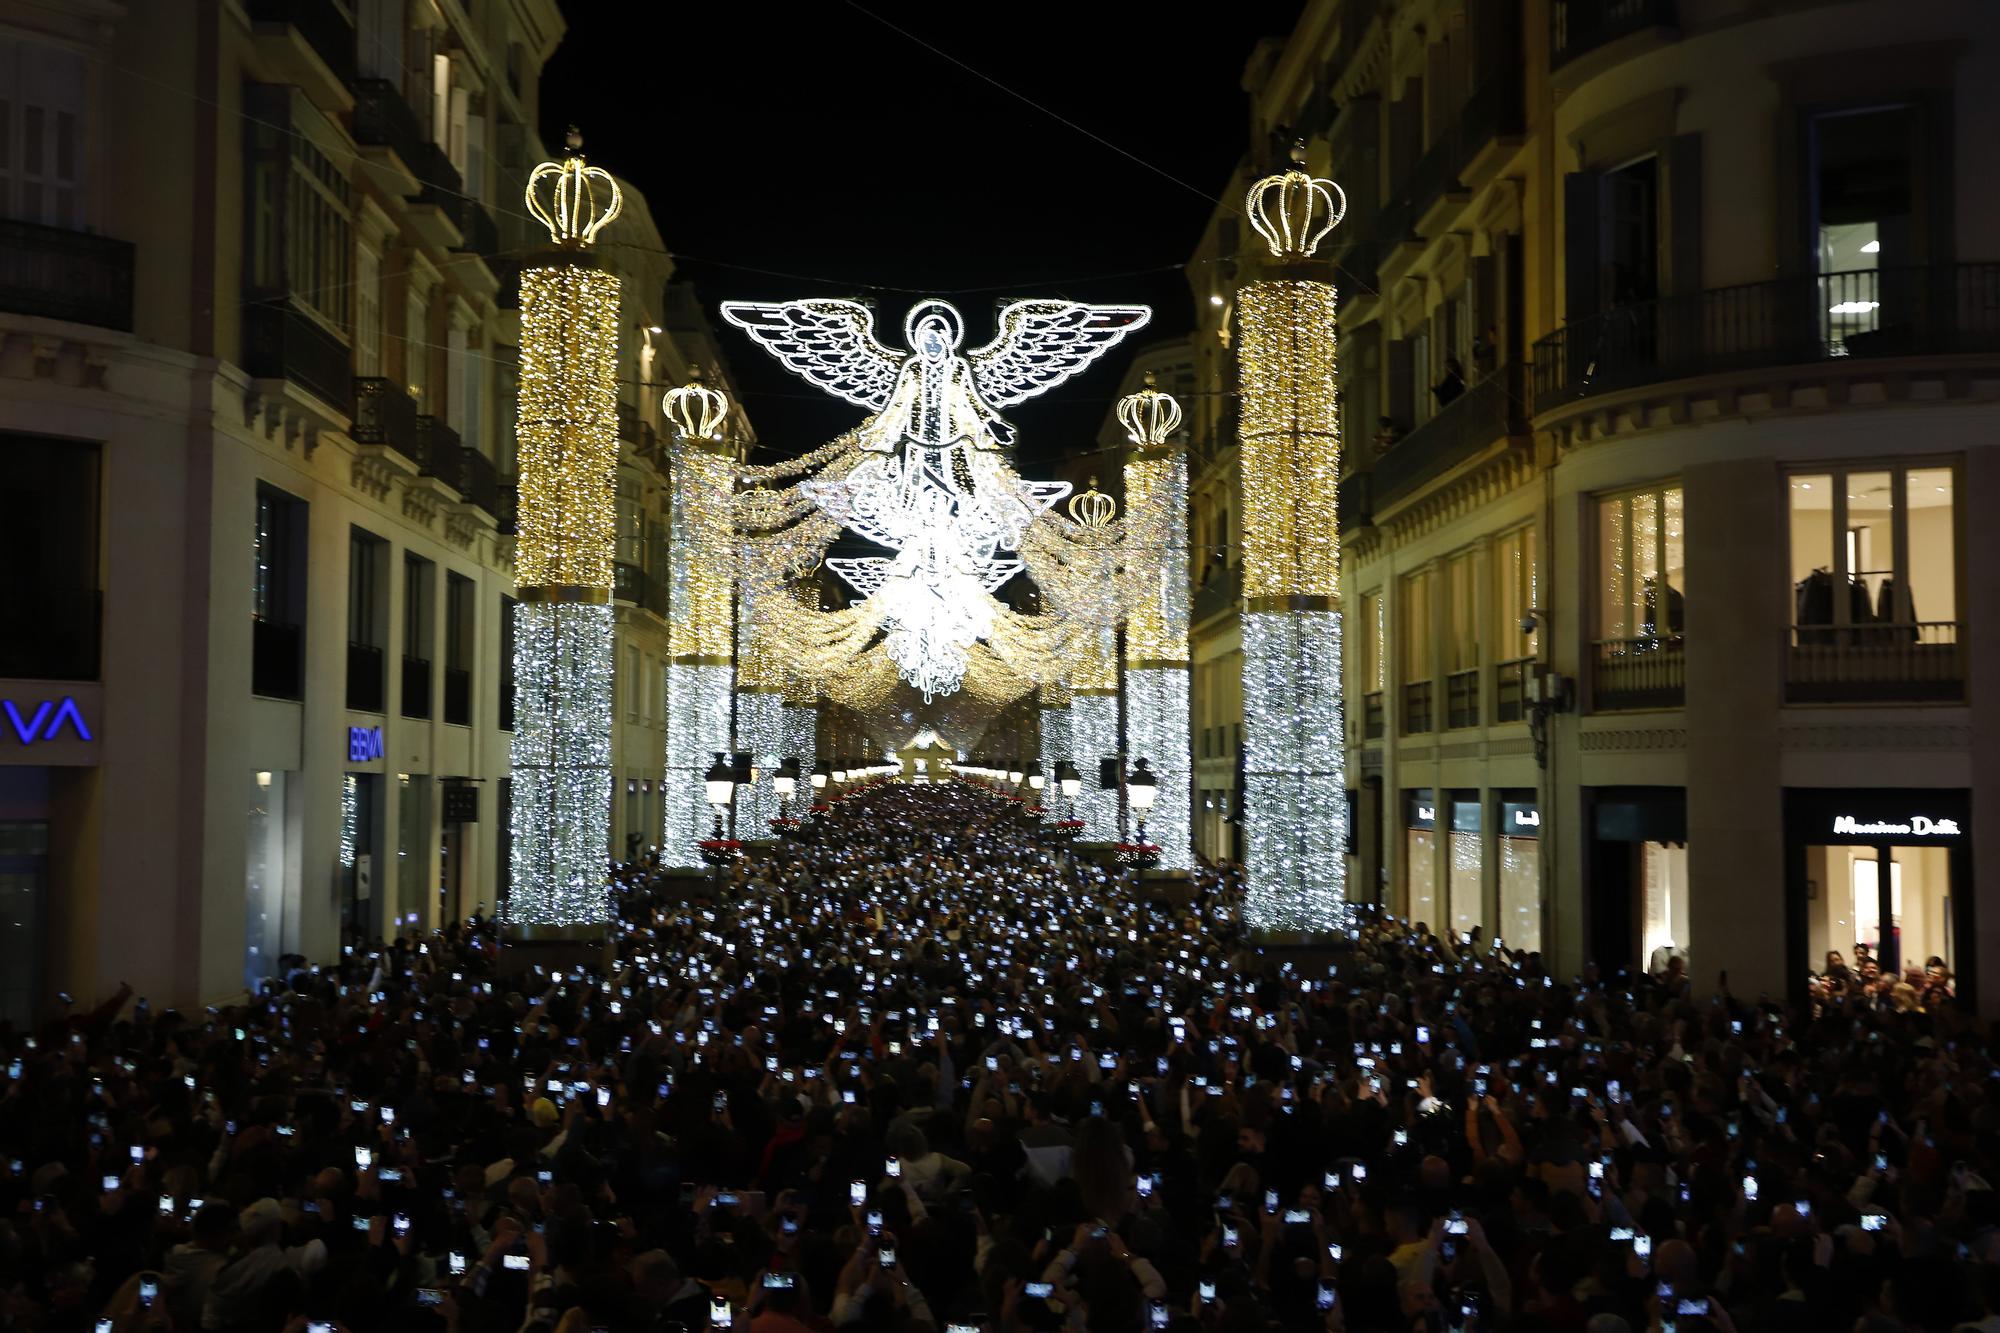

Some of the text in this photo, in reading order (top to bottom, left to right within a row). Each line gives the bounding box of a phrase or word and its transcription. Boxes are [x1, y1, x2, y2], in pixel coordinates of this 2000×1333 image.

[0, 696, 94, 745] VA
[350, 726, 384, 760] BBVA
[1833, 816, 1961, 836] Massimo Dutti
